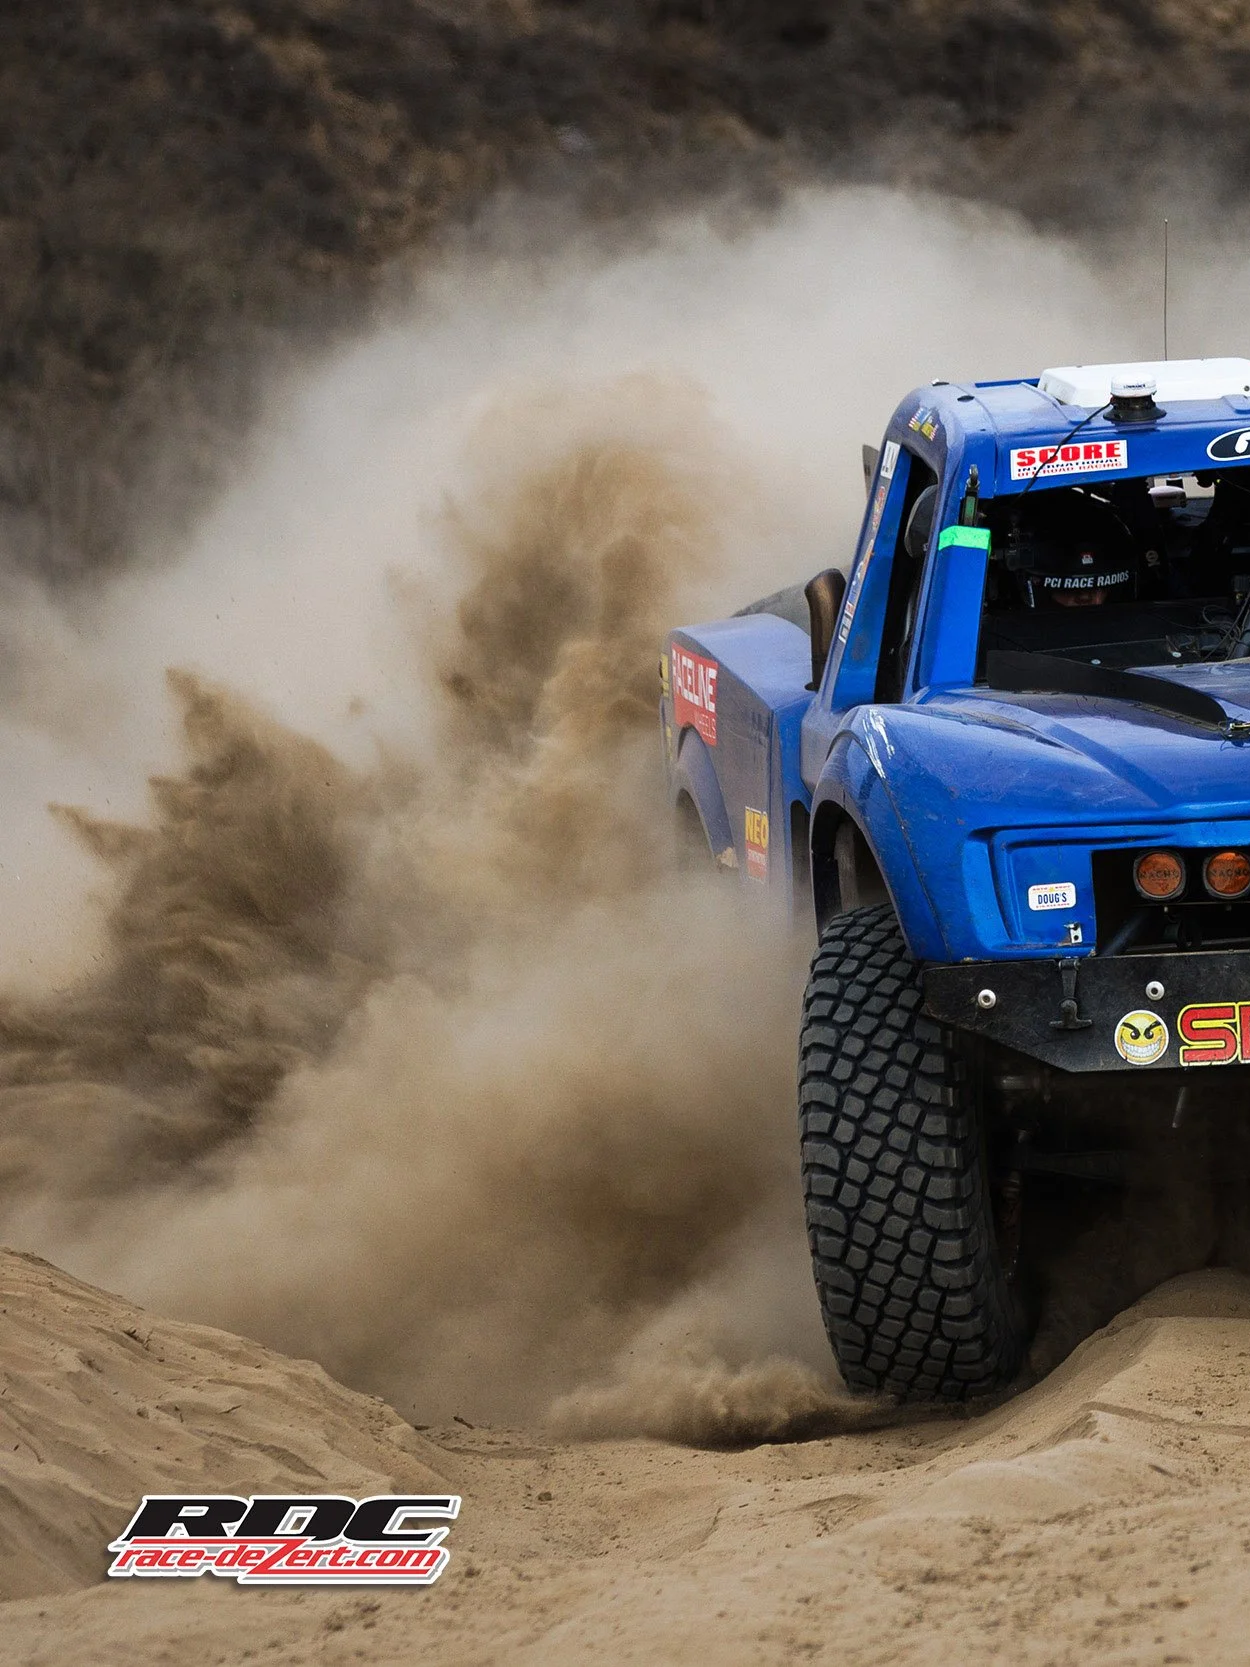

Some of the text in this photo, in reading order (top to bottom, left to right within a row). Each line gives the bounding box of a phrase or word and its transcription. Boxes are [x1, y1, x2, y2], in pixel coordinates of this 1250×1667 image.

[1016, 442, 1121, 467] SCORE
[1044, 570, 1129, 589] PCI RACE RADIOS
[1037, 892, 1068, 905] DOUG'S
